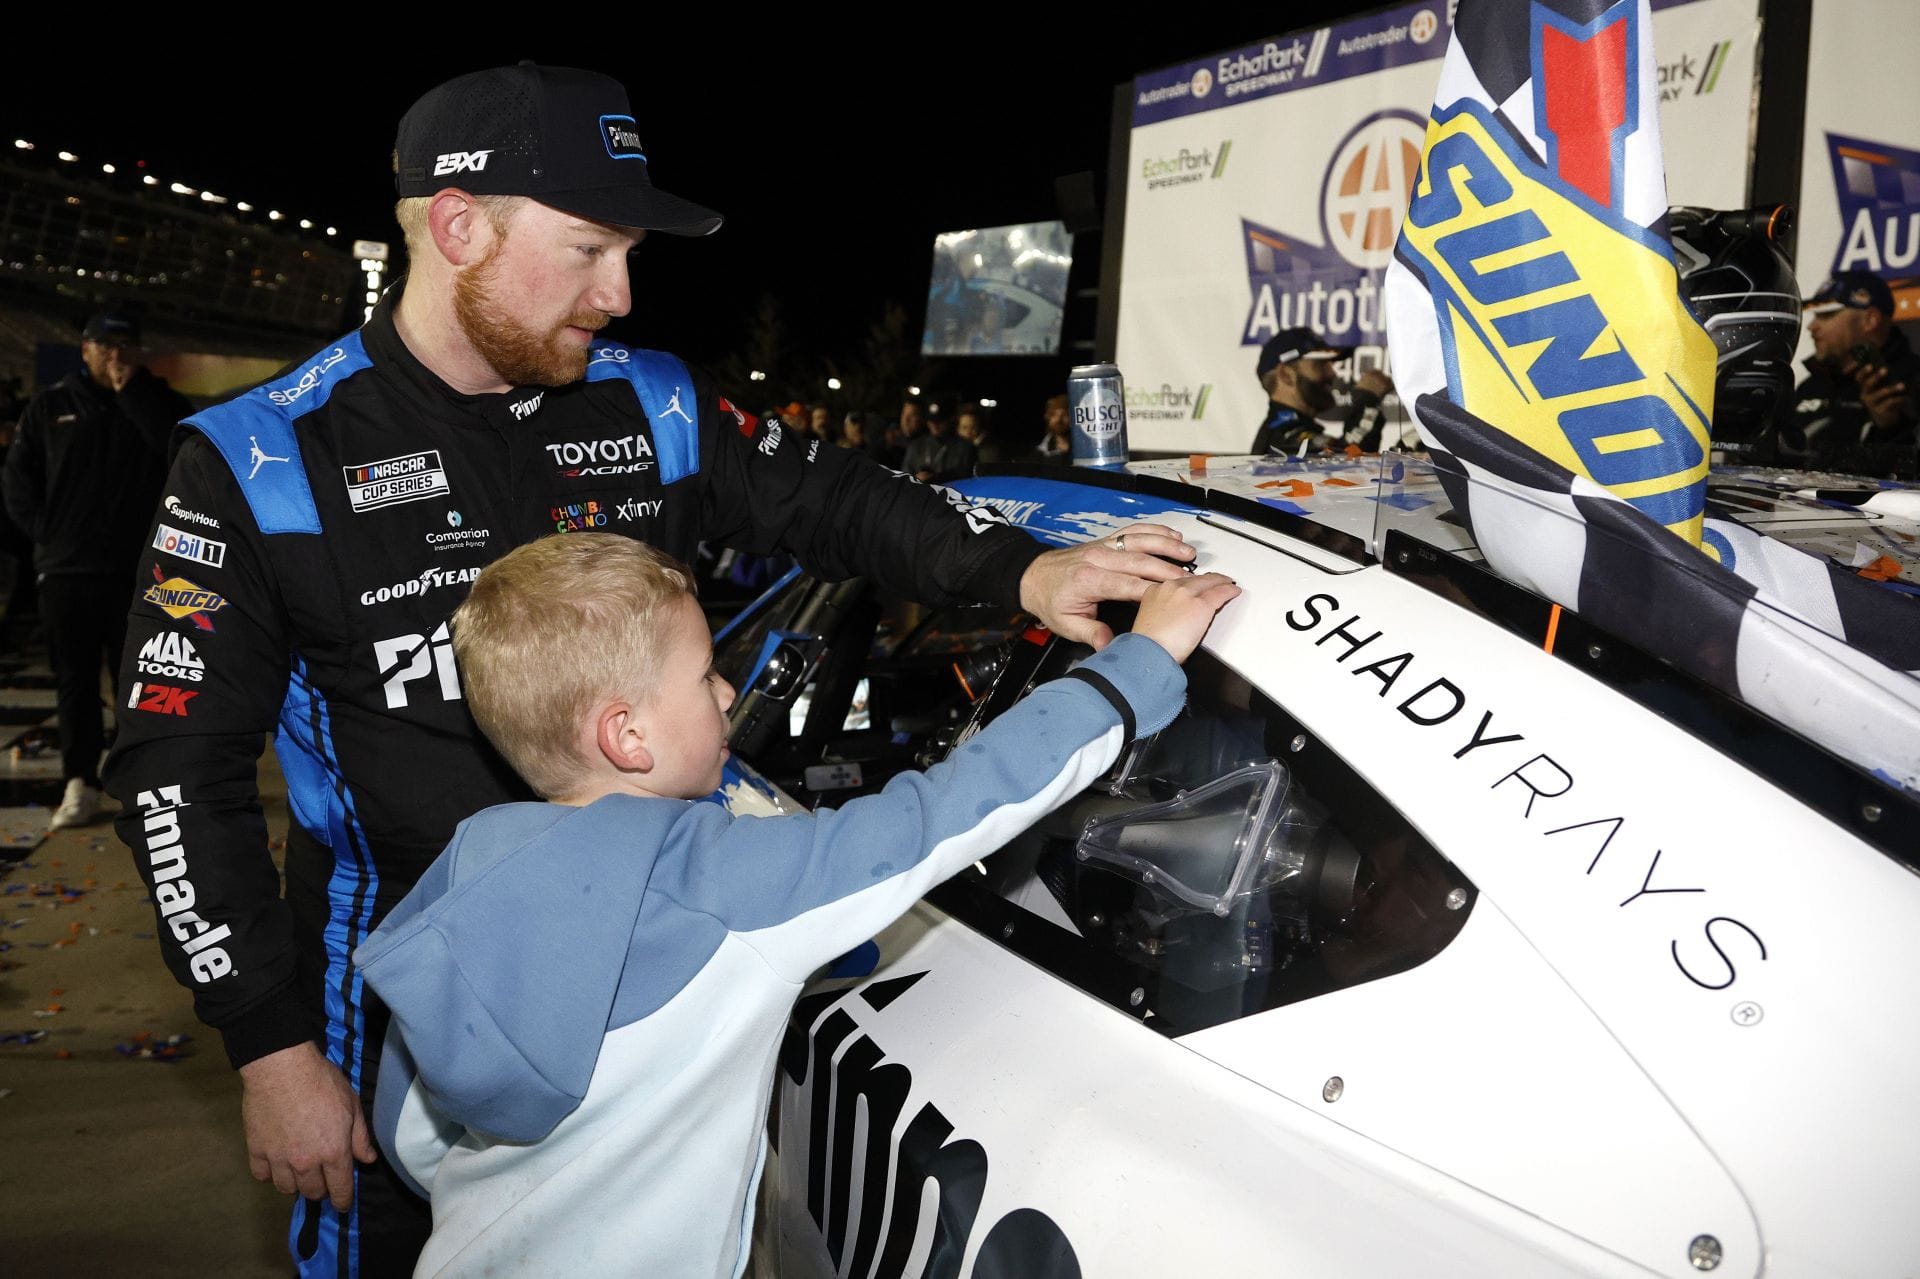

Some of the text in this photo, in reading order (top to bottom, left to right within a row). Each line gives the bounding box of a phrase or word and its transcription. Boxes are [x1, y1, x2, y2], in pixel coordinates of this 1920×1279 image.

[1218, 40, 1305, 83] EchoPark
[1225, 69, 1297, 97] SPEEDWAY
[545, 434, 653, 466] TOYOTA
[374, 456, 426, 479] NASCAR
[362, 475, 433, 501] CUP SERIES
[155, 526, 215, 561] Mobil 1
[426, 528, 490, 544] Comparion
[146, 585, 221, 610] SUNOCO
[139, 631, 205, 670] MAC
[138, 660, 204, 682] TOOLS
